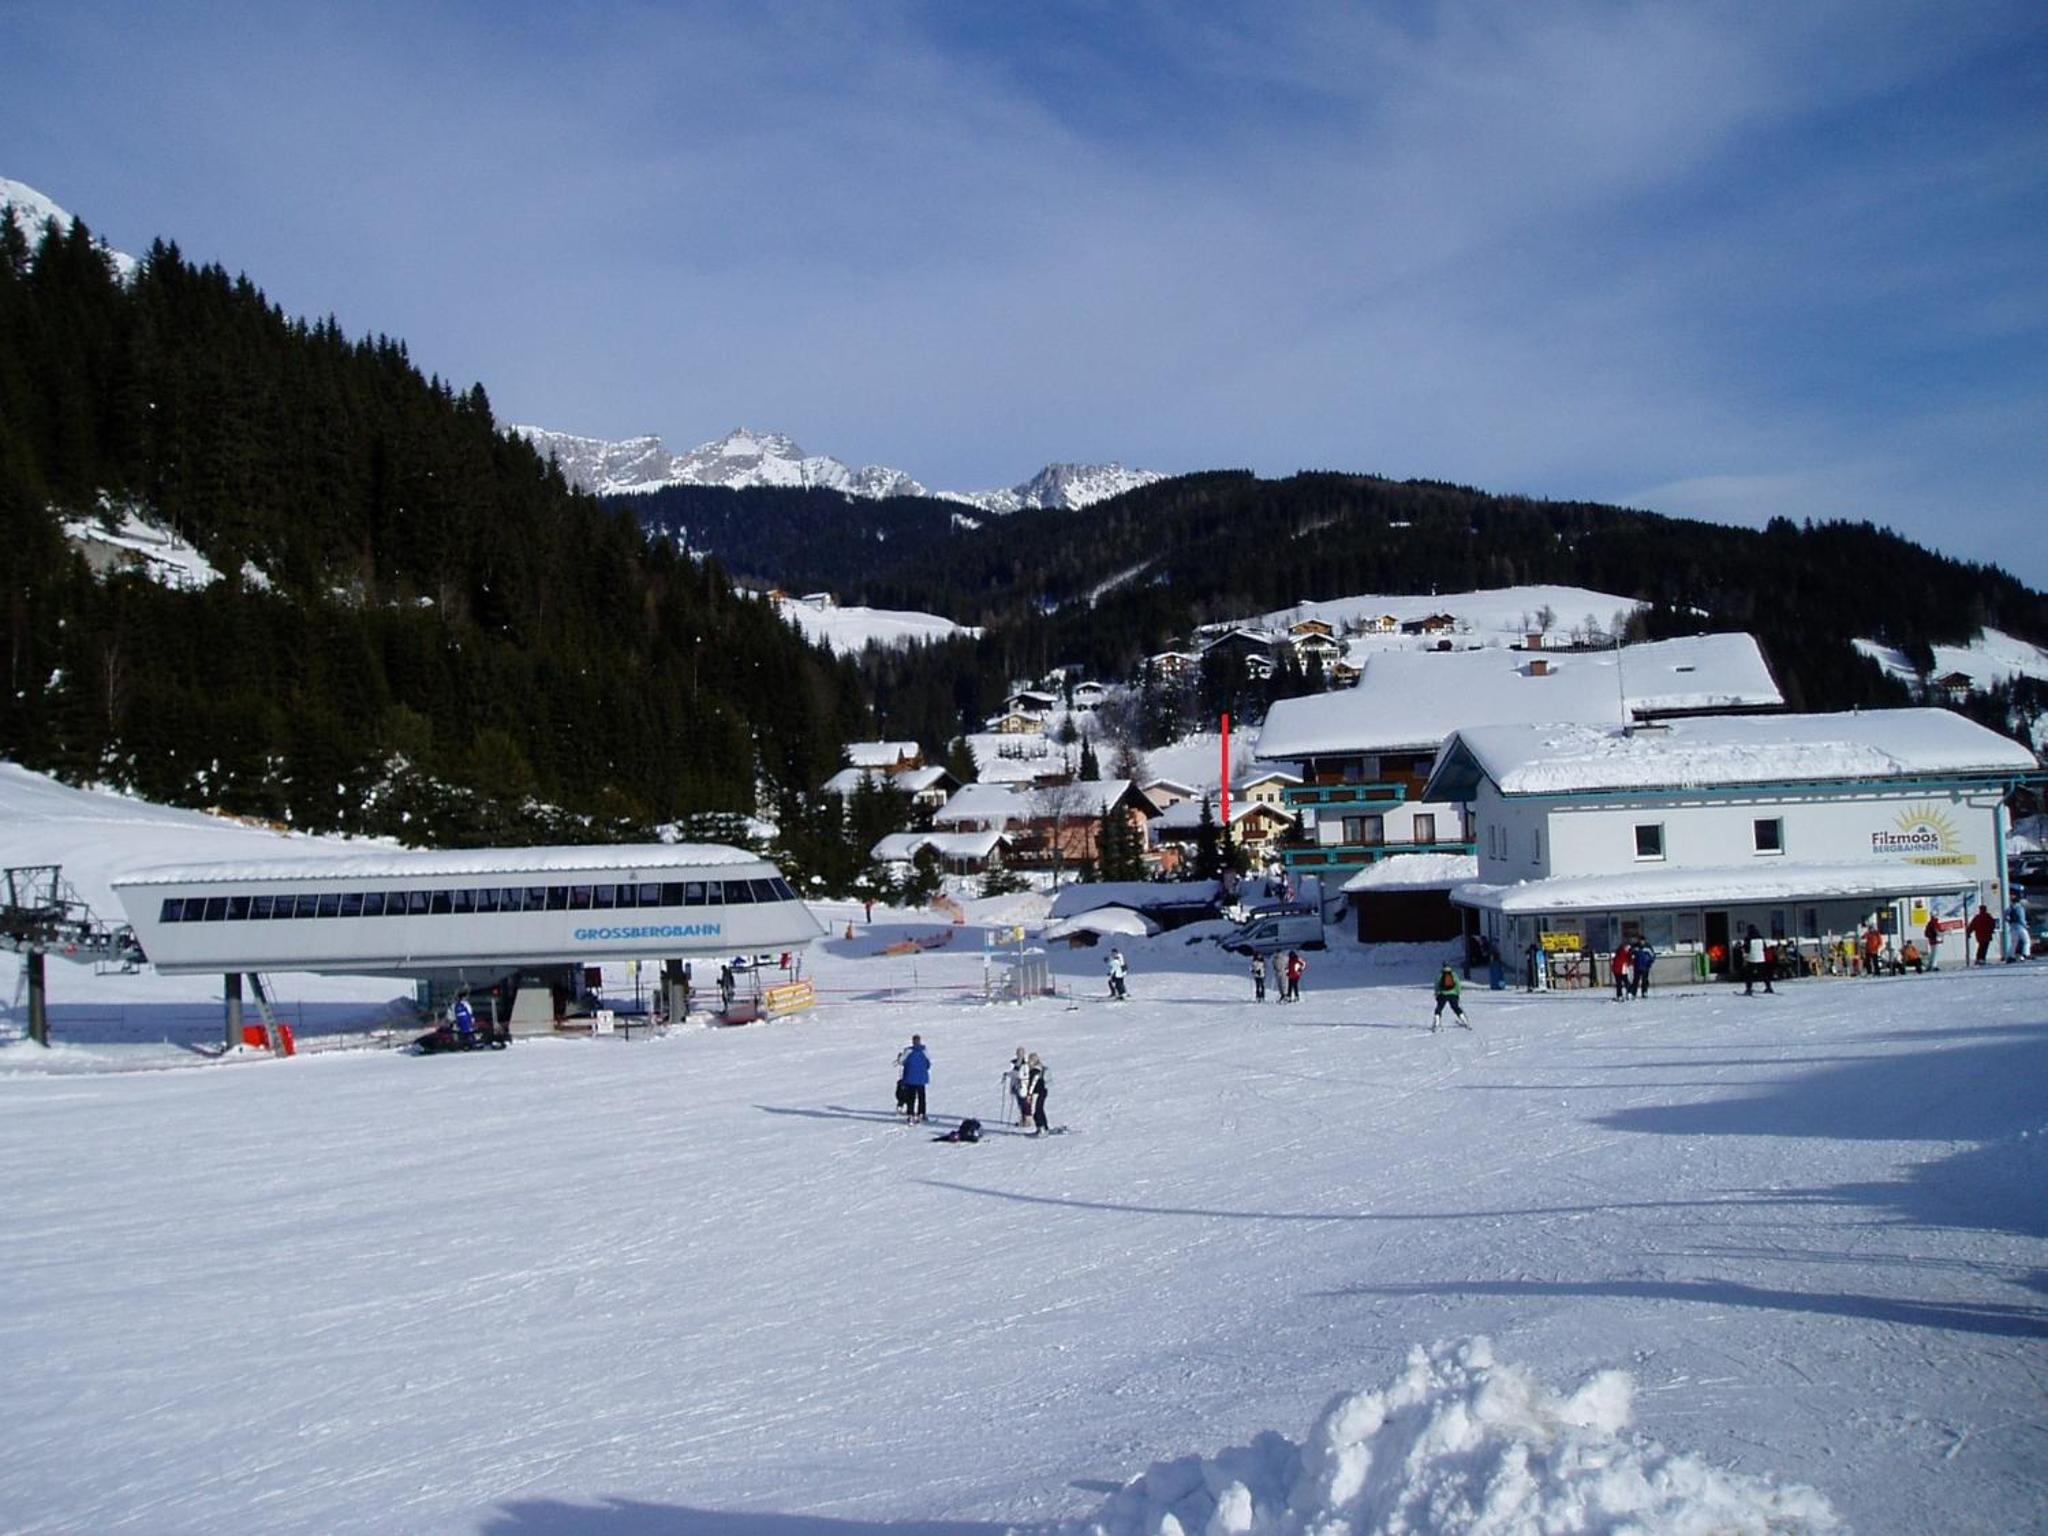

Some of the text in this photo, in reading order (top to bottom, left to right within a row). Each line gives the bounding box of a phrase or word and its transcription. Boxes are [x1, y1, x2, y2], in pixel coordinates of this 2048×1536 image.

[1872, 831, 1938, 844] Filzmoos
[1873, 843, 1939, 853] BERGBAHNEN
[575, 924, 721, 939] GROSSBERGBAHN
